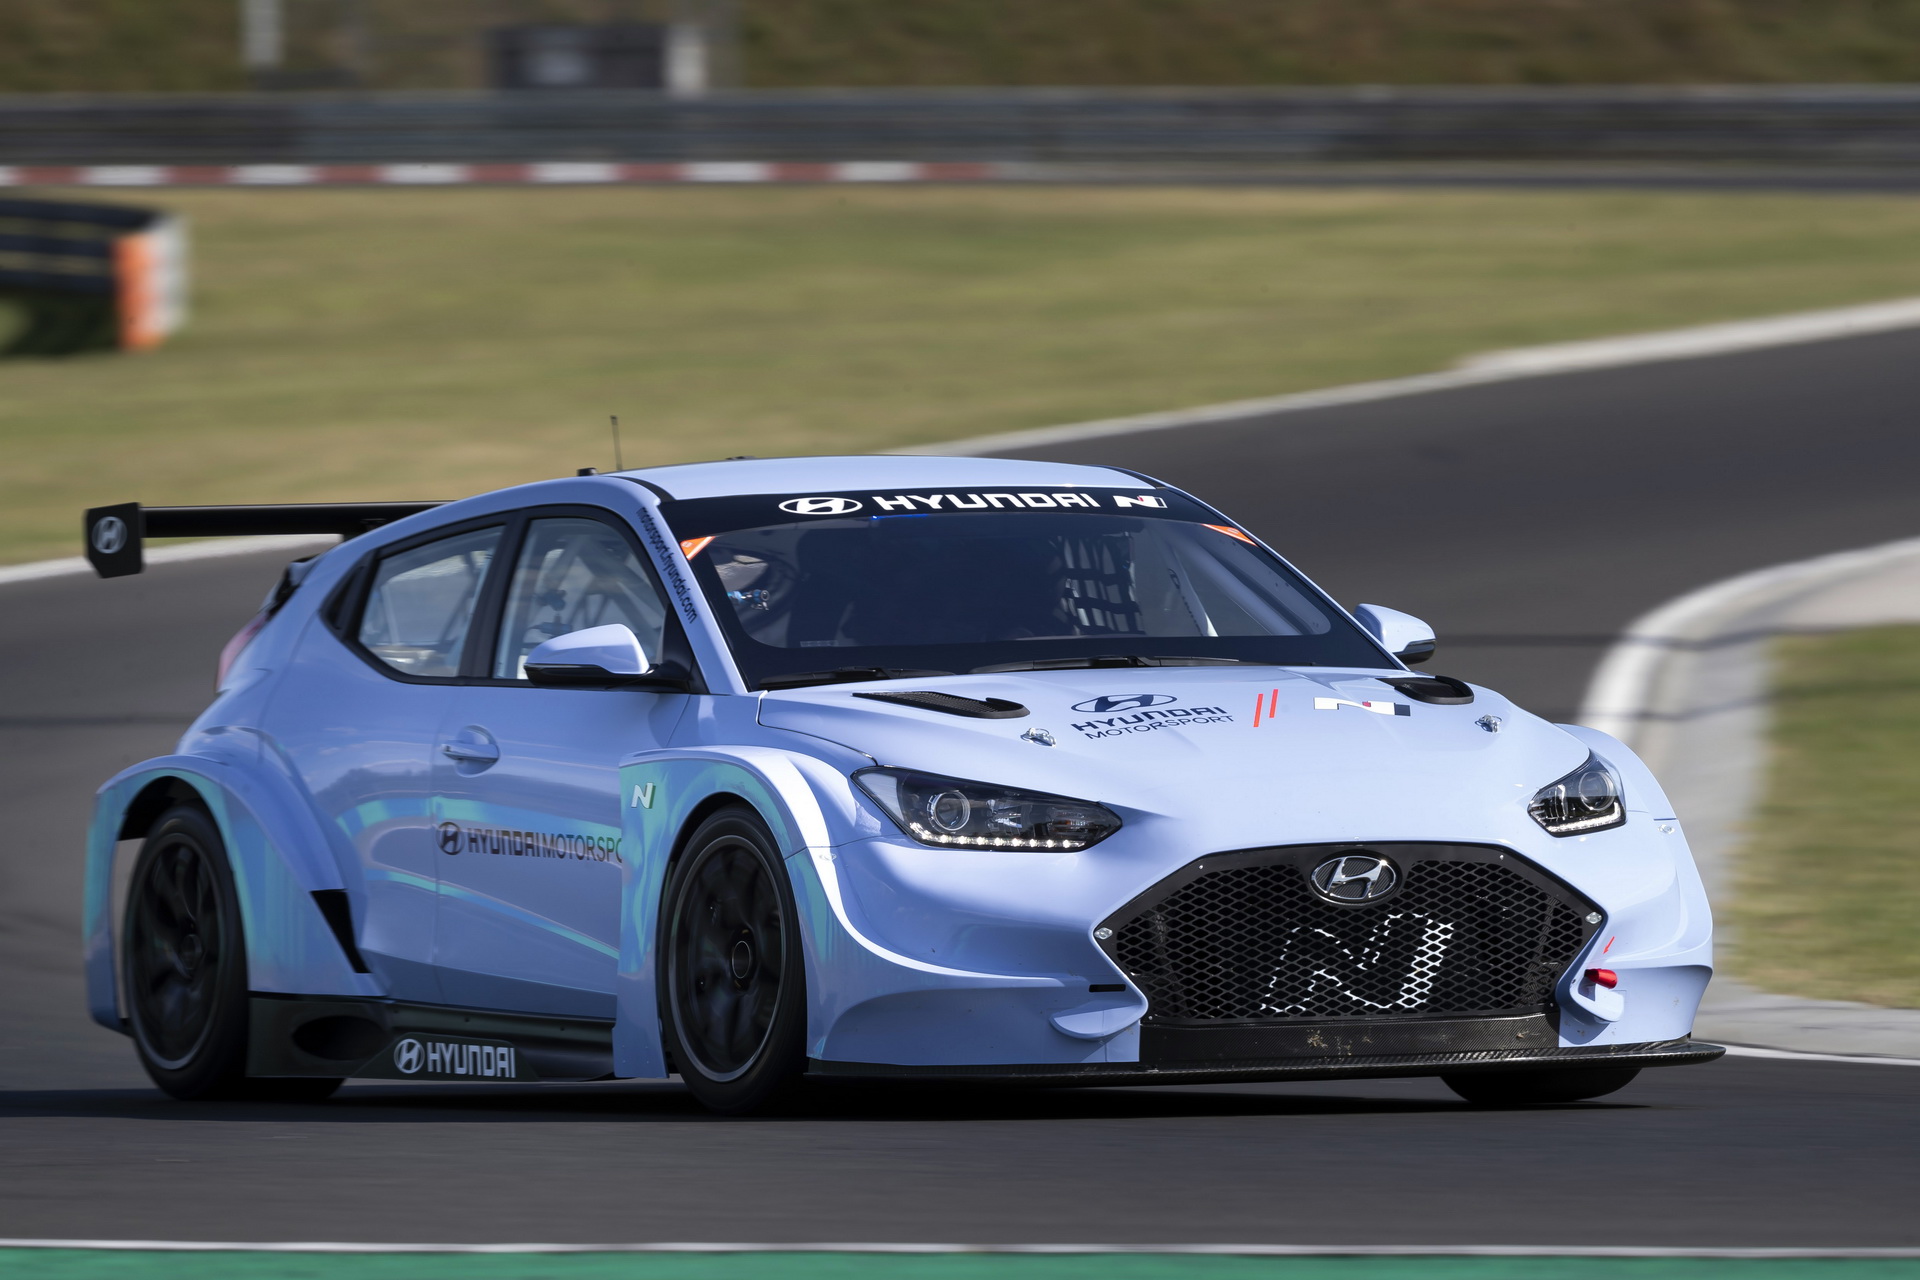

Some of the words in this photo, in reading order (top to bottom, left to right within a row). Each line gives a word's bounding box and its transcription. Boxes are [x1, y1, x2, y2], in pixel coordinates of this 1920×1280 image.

[871, 493, 1101, 512] HYUNDAI
[636, 506, 698, 624] motorsport.hyundai.com
[1071, 705, 1227, 731] HYUNDAI
[1084, 714, 1234, 740] MOTORSPORT
[631, 782, 656, 810] N
[427, 1042, 516, 1078] HYUNDAI
